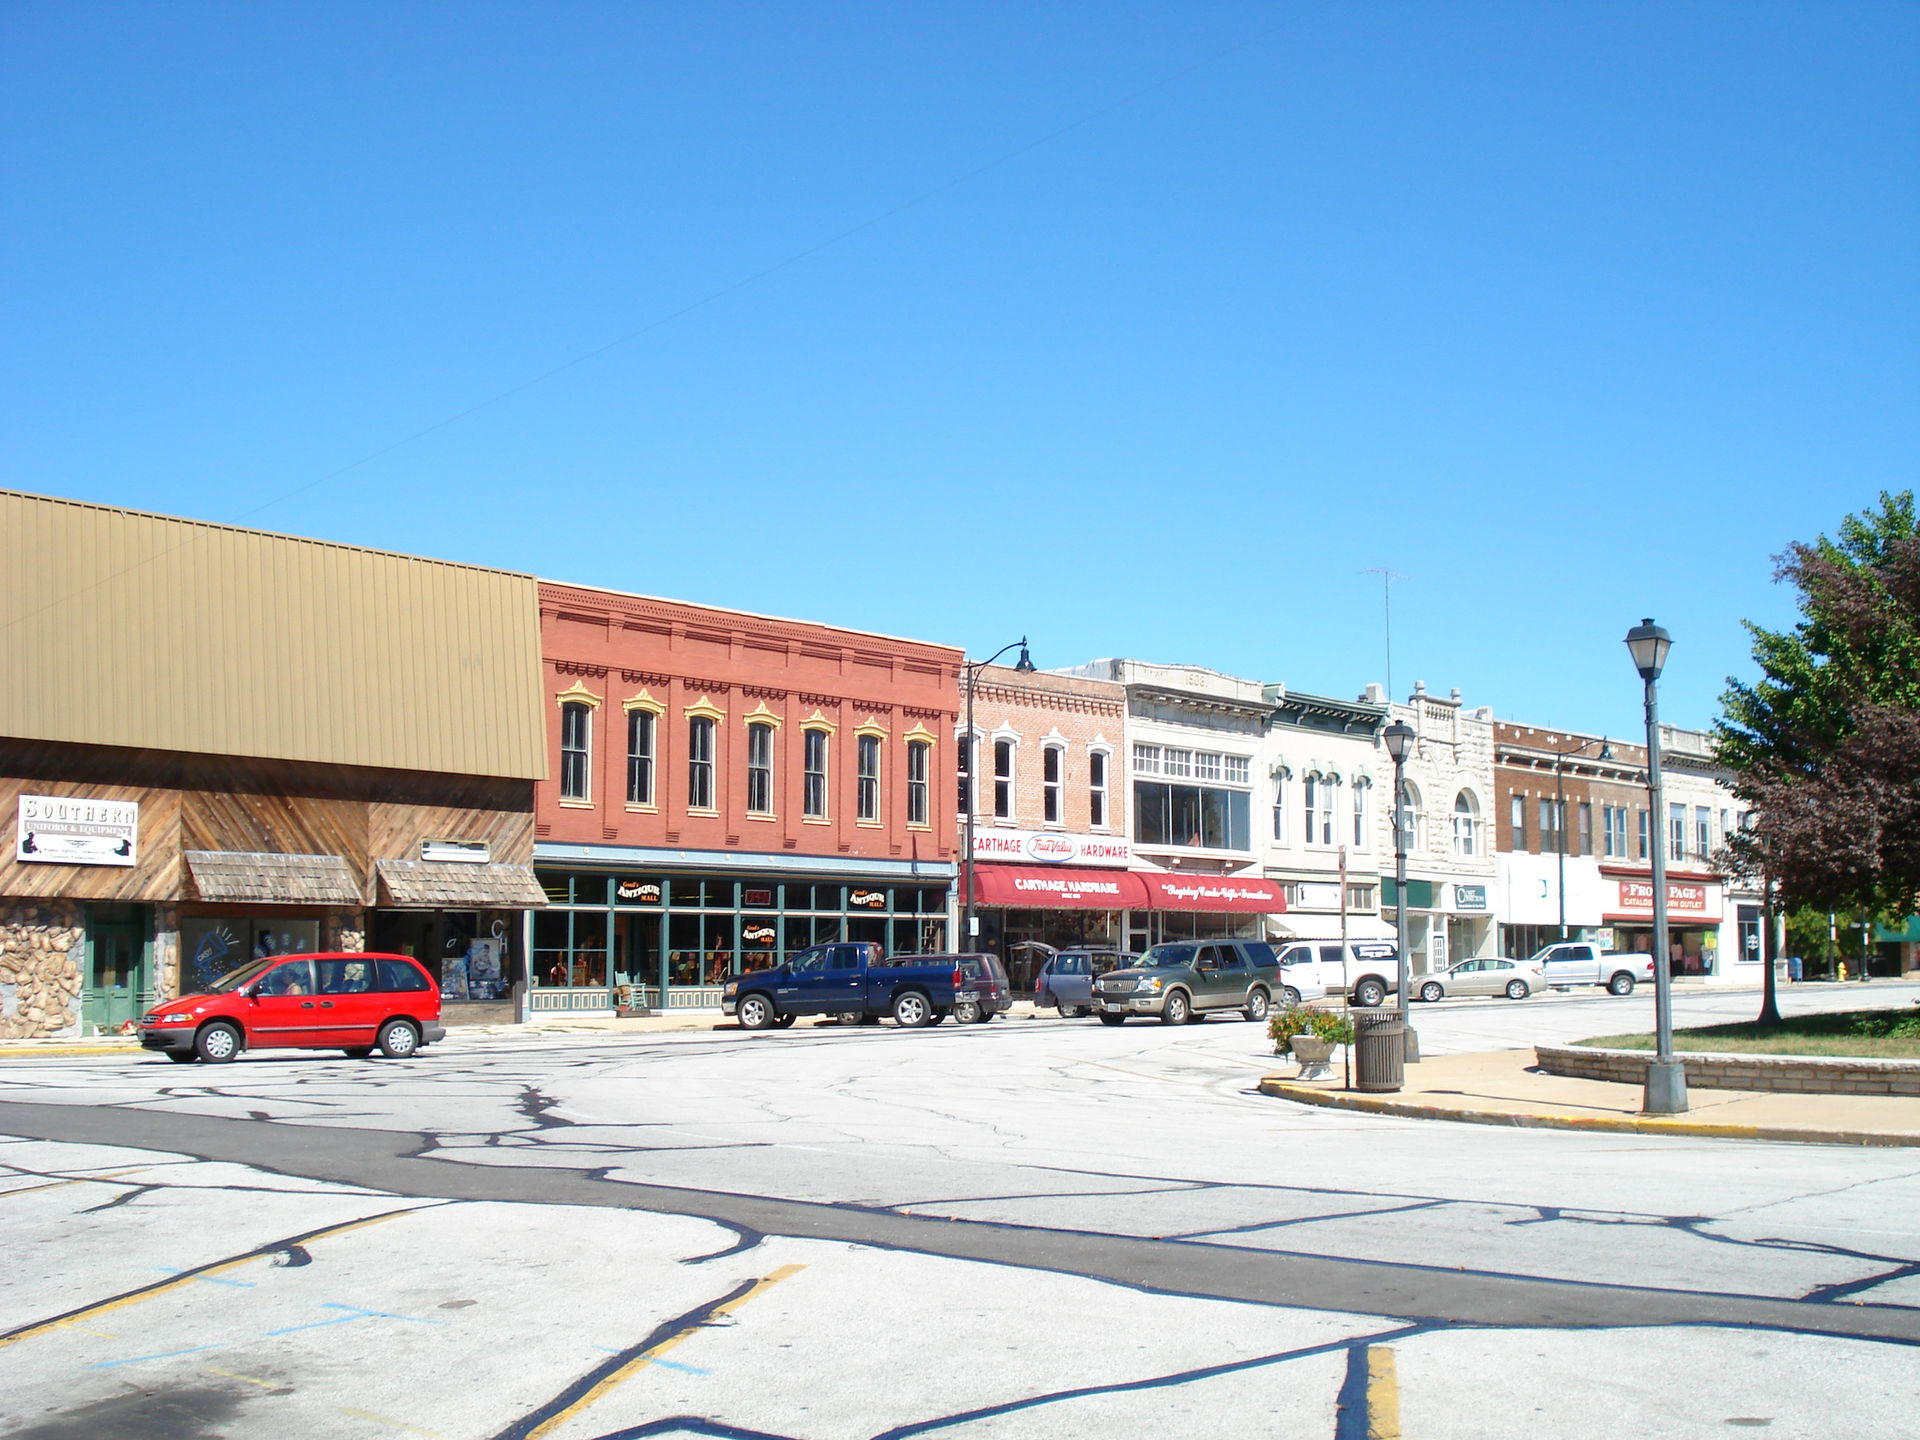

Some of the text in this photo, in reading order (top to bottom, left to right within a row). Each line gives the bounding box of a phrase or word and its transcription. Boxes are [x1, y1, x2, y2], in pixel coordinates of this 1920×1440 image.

[24, 800, 135, 823] SOUTHERN
[26, 822, 68, 832] UNIFORM
[79, 825, 129, 836] EQUIPMENT
[1032, 838, 1072, 853] True Value
[1080, 844, 1128, 859] HARDWARE
[617, 884, 660, 898] ANTIQUE
[1015, 878, 1120, 894] CARTHAGE HARDWARE
[1629, 883, 1697, 899] FRO PAGE
[850, 892, 884, 904] ANTIQUE
[742, 928, 776, 940] ANTIQUE
